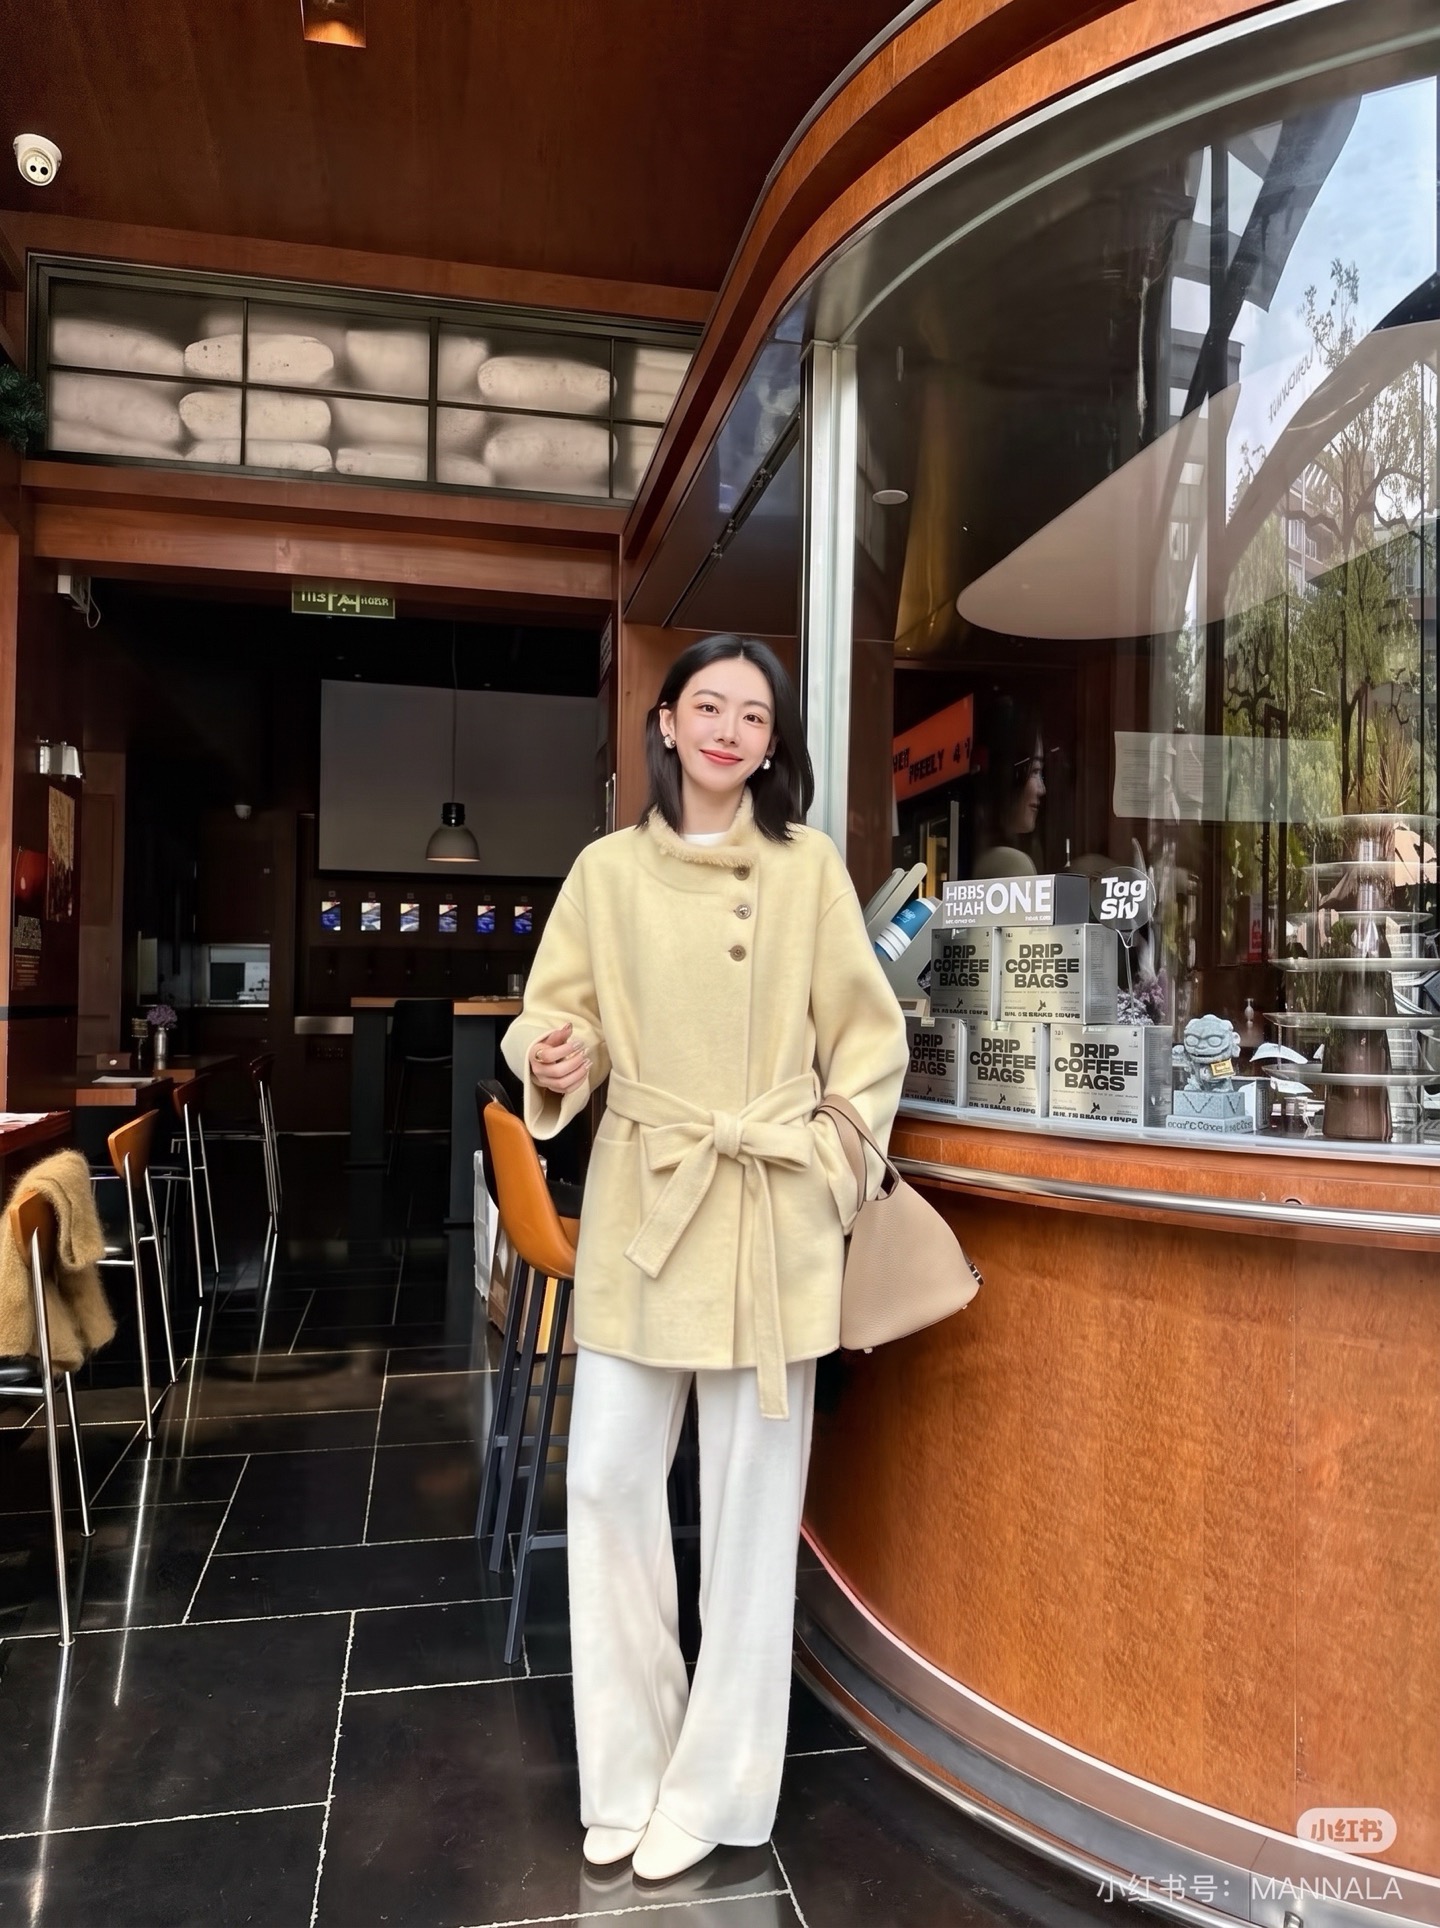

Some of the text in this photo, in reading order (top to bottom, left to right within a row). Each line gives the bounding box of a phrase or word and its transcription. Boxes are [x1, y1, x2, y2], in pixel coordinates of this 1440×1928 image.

[985, 879, 1052, 915] ONE
[1101, 876, 1147, 902] Tag
[943, 944, 977, 959] DRIP
[1019, 943, 1063, 959] DRIP
[933, 958, 990, 973] COFFEE
[1005, 958, 1080, 974] COFFEE
[939, 973, 980, 987] BAGS
[1014, 973, 1069, 989] BAGS
[913, 1033, 943, 1048] DRIP
[981, 1037, 1021, 1053] DRIP
[1069, 1042, 1120, 1059] DRIP
[910, 1060, 947, 1076] BAGS
[969, 1051, 1036, 1070] COFFEE
[1054, 1057, 1138, 1076] COFFEE
[977, 1066, 1025, 1084] BAGS
[1064, 1073, 1126, 1092] BAGS
